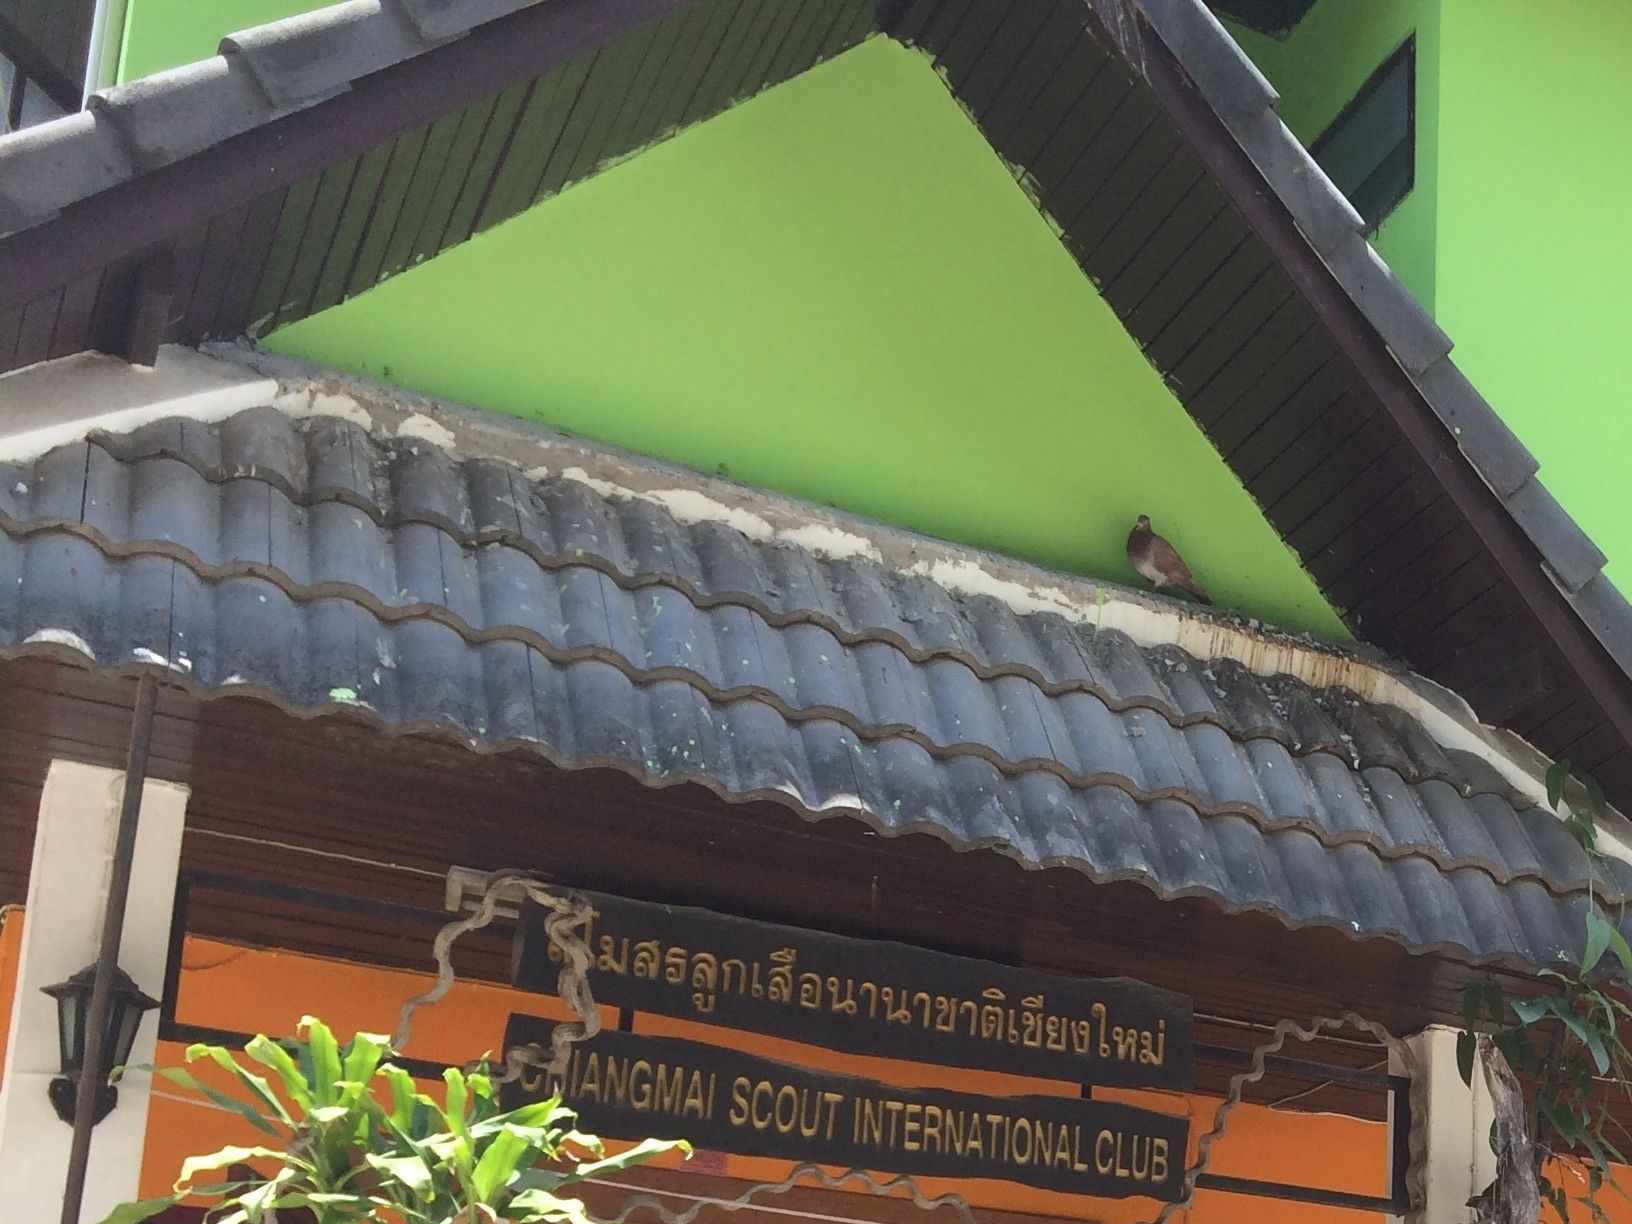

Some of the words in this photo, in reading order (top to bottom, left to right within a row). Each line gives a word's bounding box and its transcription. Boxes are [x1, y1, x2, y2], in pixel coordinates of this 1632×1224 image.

[729, 1076, 844, 1140] SCOUT
[853, 1097, 1089, 1172] INTERNATIONAL
[1095, 1129, 1169, 1184] CLUB
